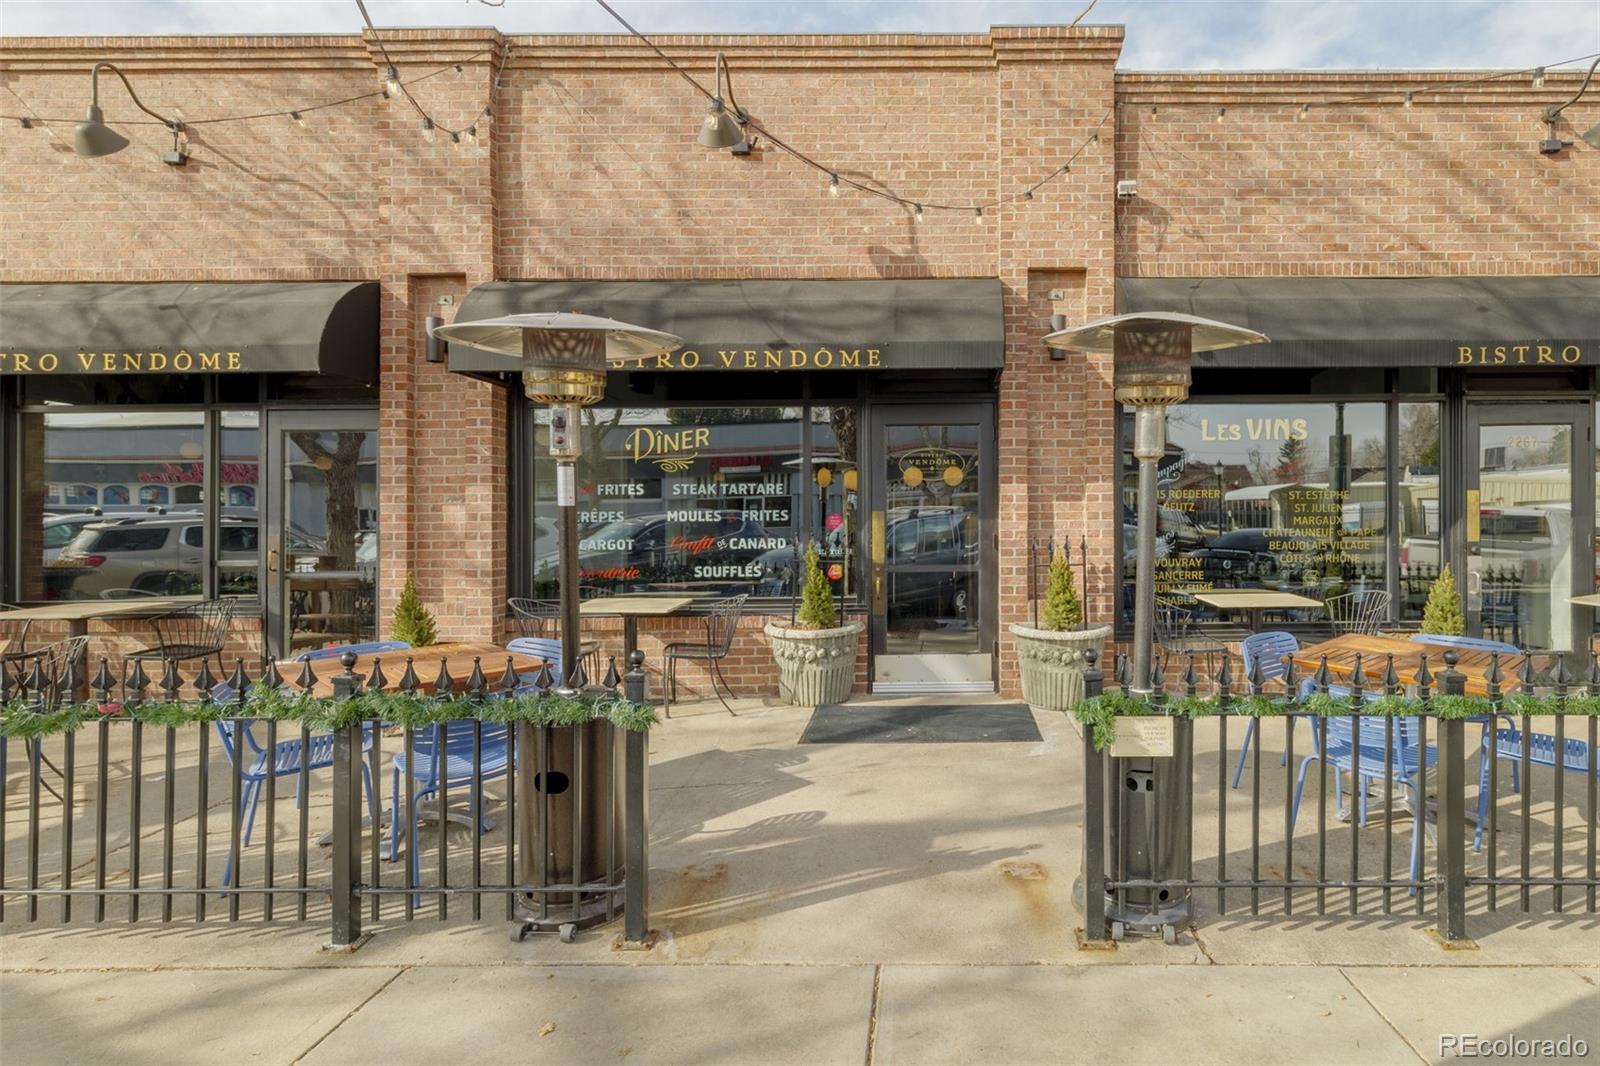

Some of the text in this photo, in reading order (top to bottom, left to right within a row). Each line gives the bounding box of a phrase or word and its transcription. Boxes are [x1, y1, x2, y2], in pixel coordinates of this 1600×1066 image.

[718, 347, 881, 368] VENDÔME
[1457, 345, 1581, 364] BISTRO
[77, 350, 241, 371] VENDÔME
[1245, 418, 1308, 441] VINS
[625, 427, 710, 464] DÎNER
[908, 457, 957, 465] VENDÔME
[597, 483, 645, 496] FRITES
[672, 483, 783, 495] STEAK TARTARE
[1168, 489, 1221, 499] ROEDERER
[1294, 503, 1344, 513] ST. JULIEN
[667, 510, 721, 522] MOULES
[741, 509, 789, 521] FRITES
[1293, 516, 1343, 525] MARGAUX
[729, 538, 786, 549] CANARD
[1268, 541, 1369, 550] BEAUJOLAIS VILLAGE
[1154, 558, 1202, 568] VOUVRAY
[1153, 570, 1204, 580] SANCERRE
